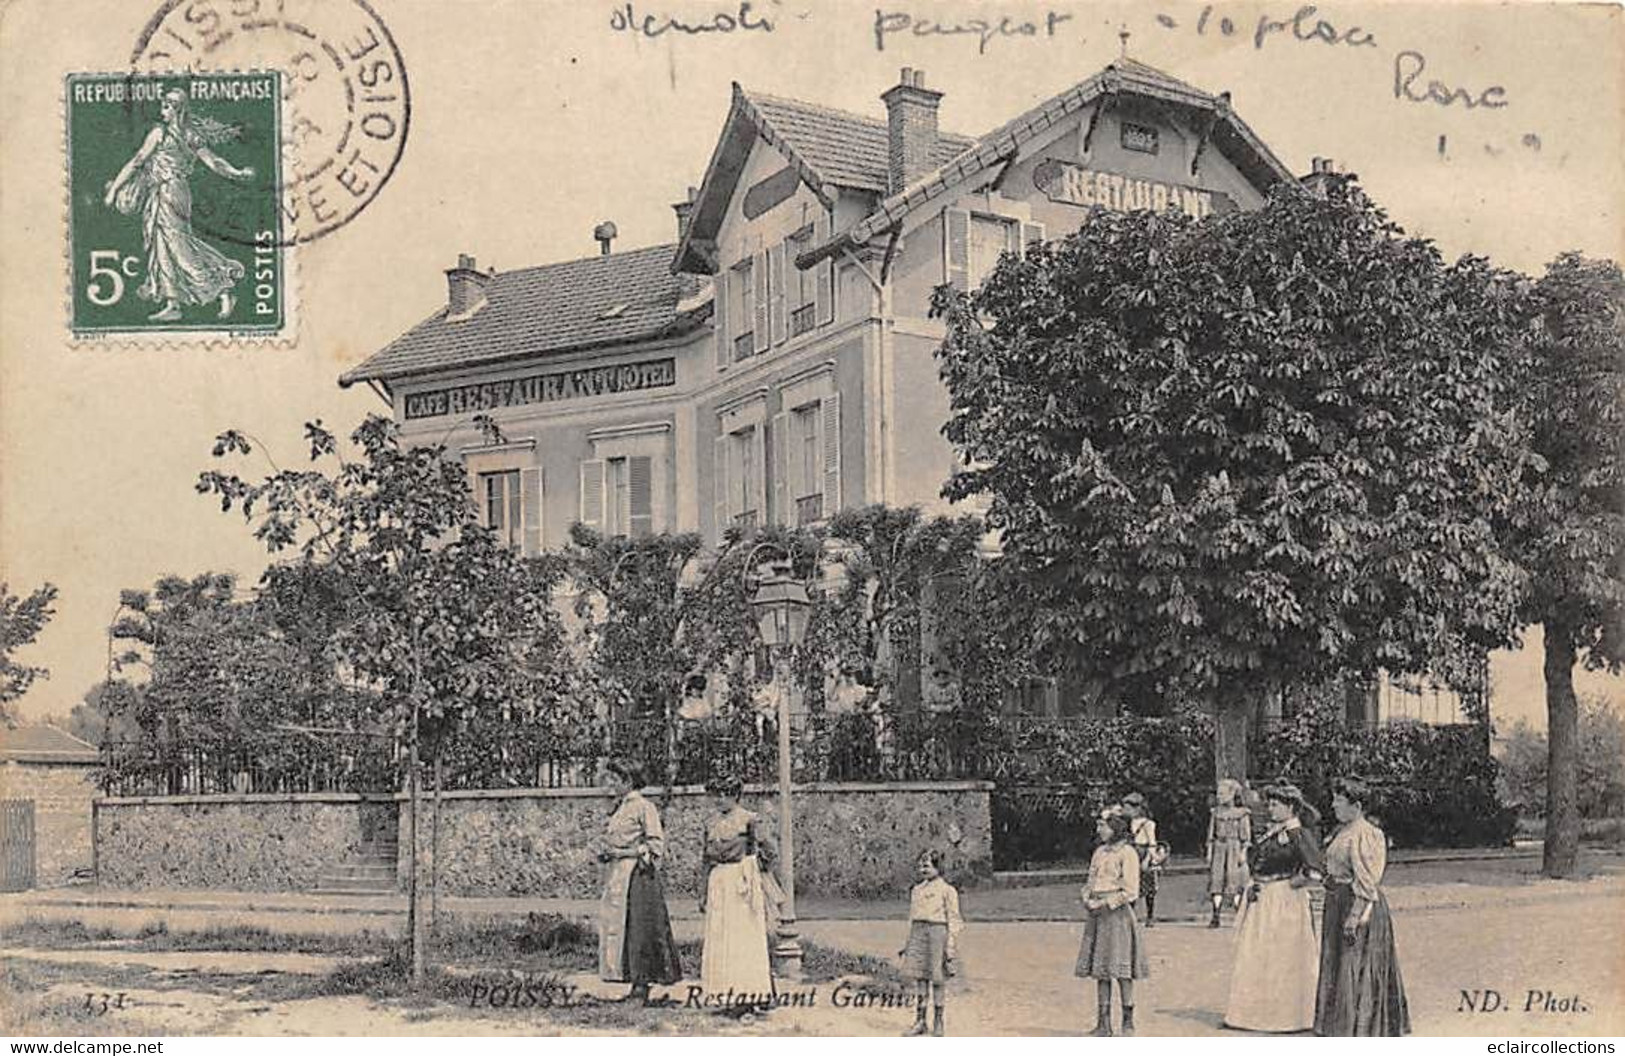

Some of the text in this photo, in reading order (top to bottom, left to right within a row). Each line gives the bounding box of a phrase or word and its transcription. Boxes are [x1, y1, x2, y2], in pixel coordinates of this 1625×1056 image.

[190, 79, 272, 101] FRANÇAISE
[1063, 164, 1212, 219] RESTAURANT
[256, 229, 274, 315] POSTES
[448, 367, 612, 414] RESTAURANT
